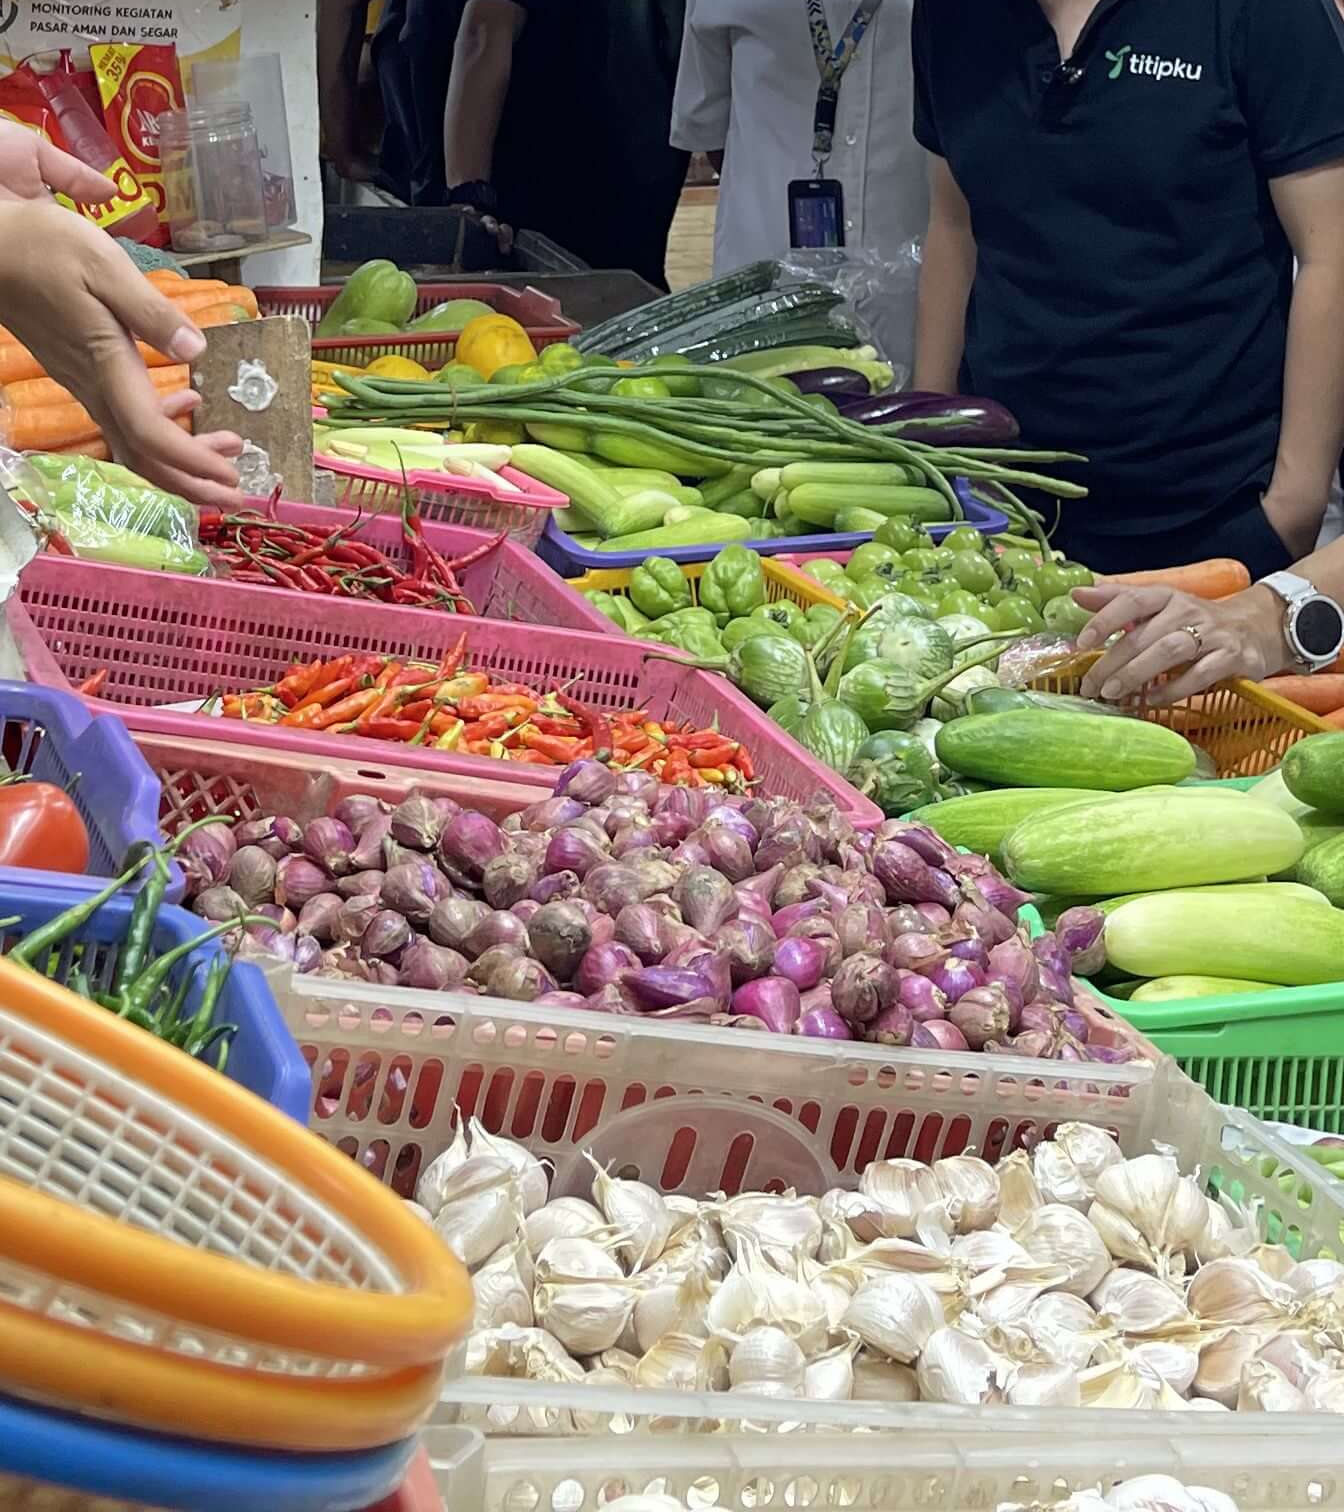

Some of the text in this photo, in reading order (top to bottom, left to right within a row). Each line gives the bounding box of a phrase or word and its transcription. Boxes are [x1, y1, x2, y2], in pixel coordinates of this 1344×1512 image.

[31, 2, 173, 21] MONITORING KEGIATAN
[30, 21, 179, 39] PASAR AMAN DAN SEGAR
[105, 53, 127, 83] 35%
[1129, 53, 1203, 81] titipku
